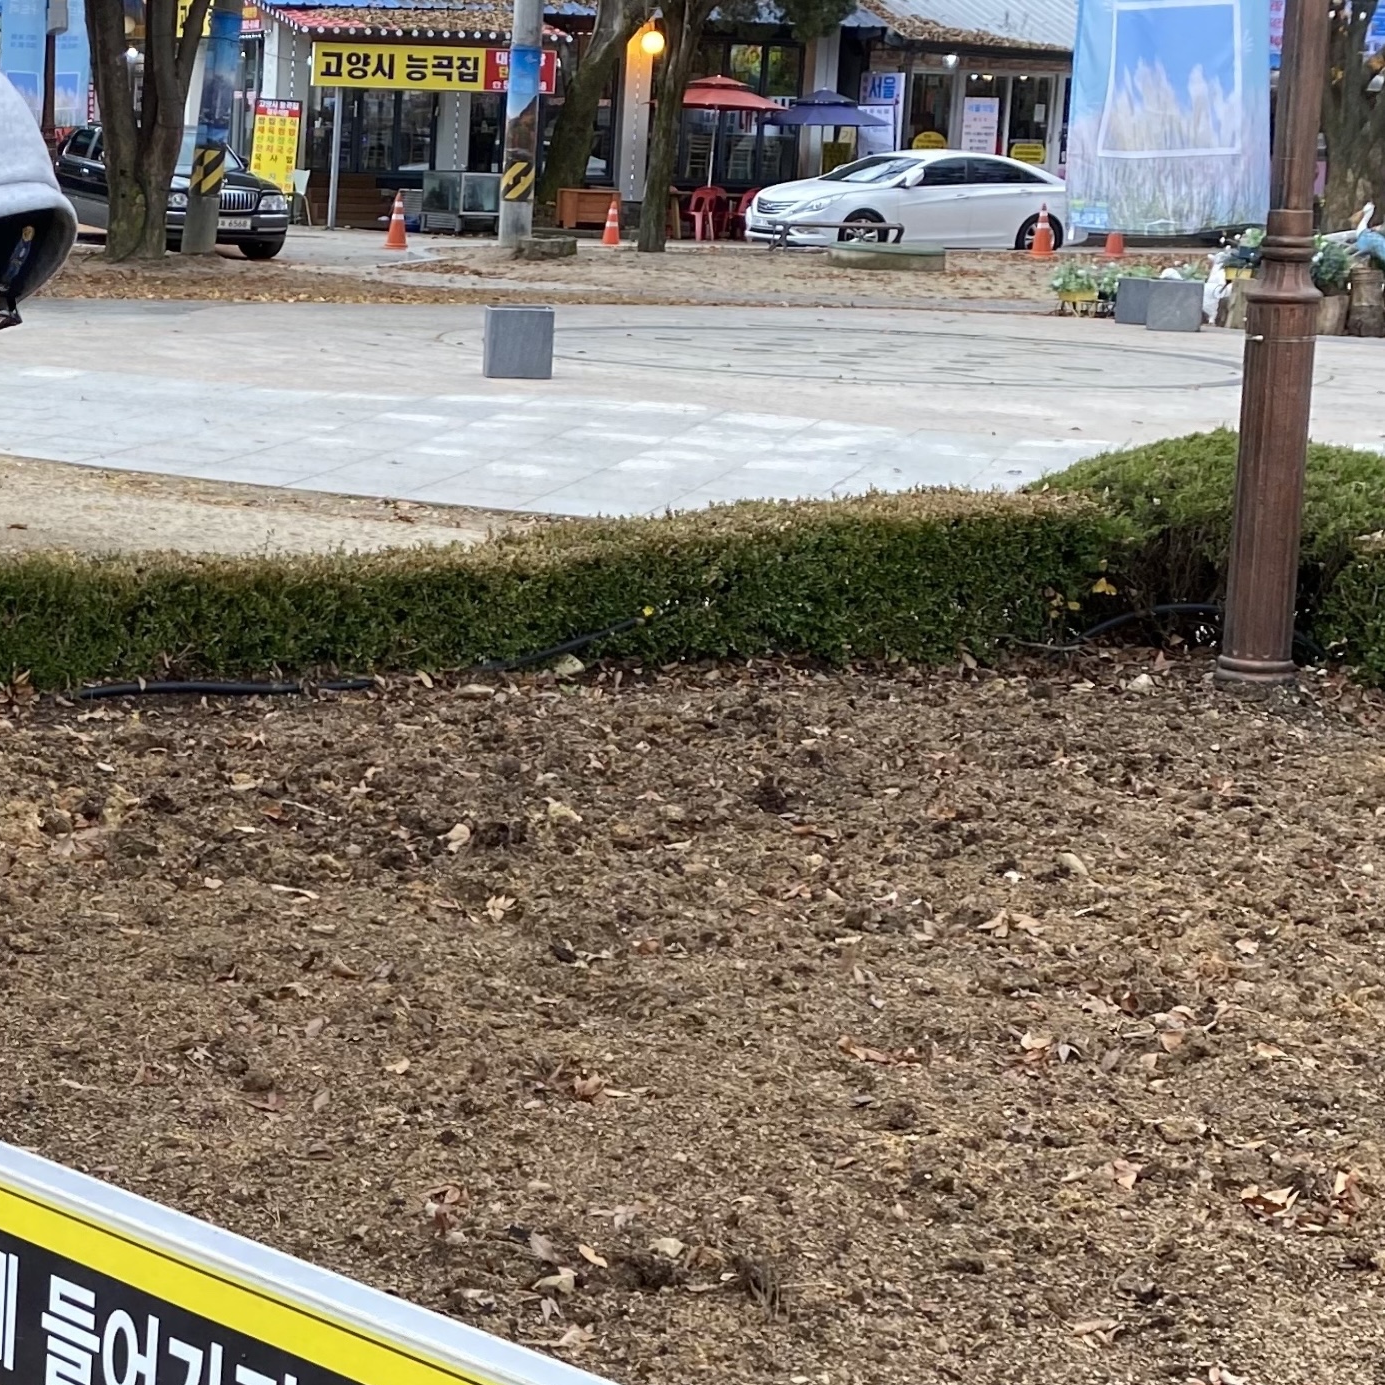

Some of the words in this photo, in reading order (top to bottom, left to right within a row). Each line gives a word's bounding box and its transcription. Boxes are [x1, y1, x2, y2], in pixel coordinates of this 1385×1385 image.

[320, 51, 395, 80] 고양시
[405, 54, 480, 83] 능곡집
[869, 76, 896, 99] 서울
